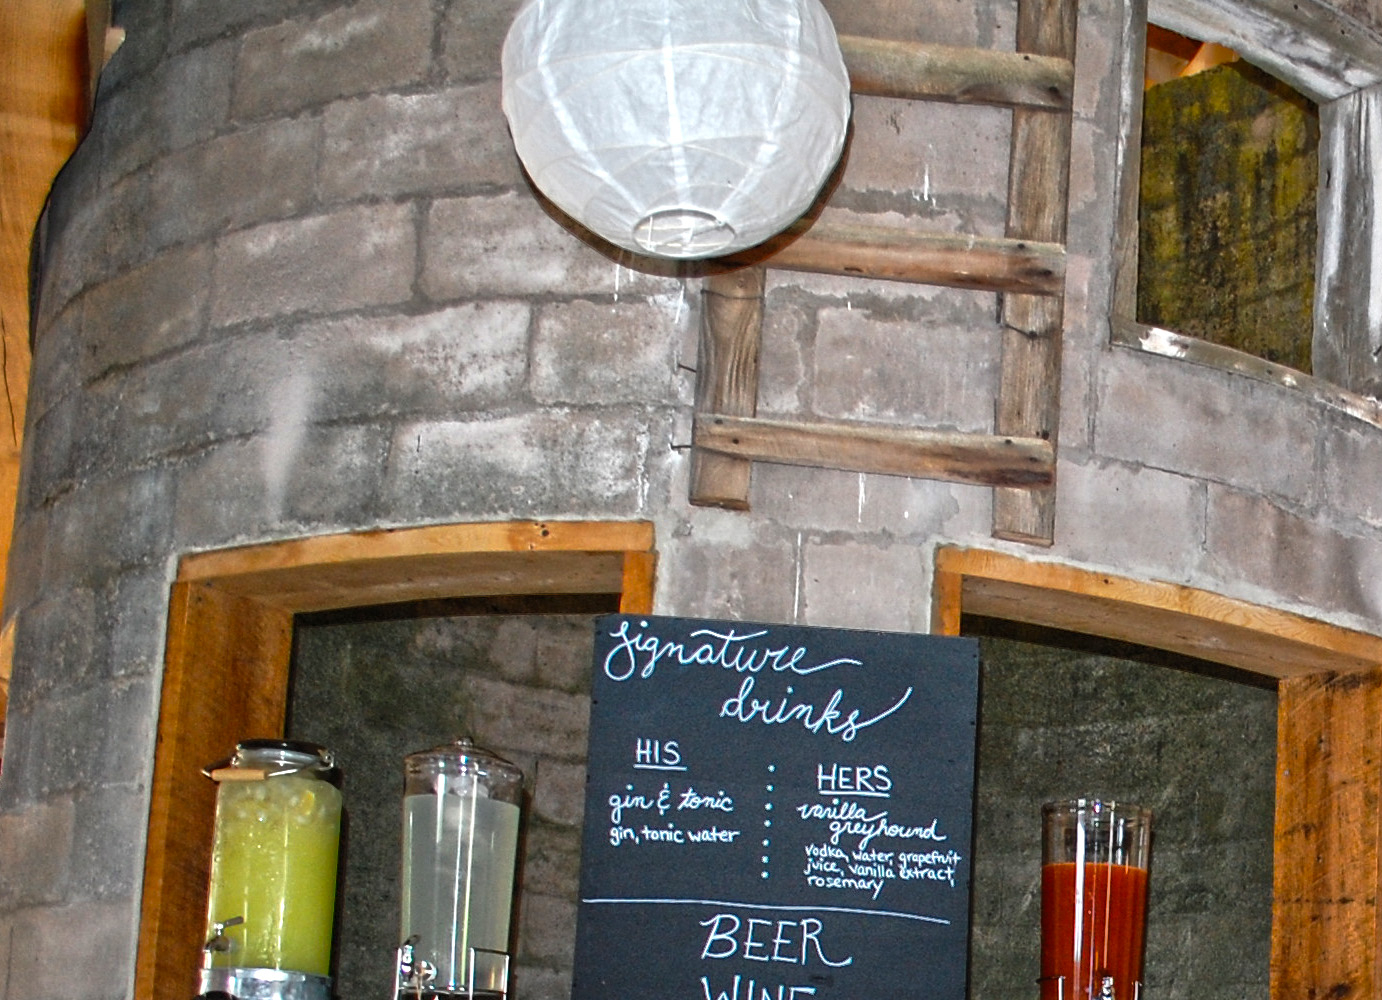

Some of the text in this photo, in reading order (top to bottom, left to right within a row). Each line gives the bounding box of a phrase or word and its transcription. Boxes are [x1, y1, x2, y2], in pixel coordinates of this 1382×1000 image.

[604, 620, 863, 681] Signature
[719, 676, 913, 742] drinks
[635, 738, 682, 765] HIS
[817, 763, 893, 792] HERS
[608, 782, 734, 825] gin & tonic
[796, 798, 889, 822] vanilla
[609, 822, 741, 846] gin, tonic water
[829, 818, 947, 851] greyhound
[804, 857, 956, 888] juice, vanilla extract,
[898, 850, 962, 869] grapefruit
[807, 875, 884, 900] rosemary
[699, 913, 853, 967] BEER
